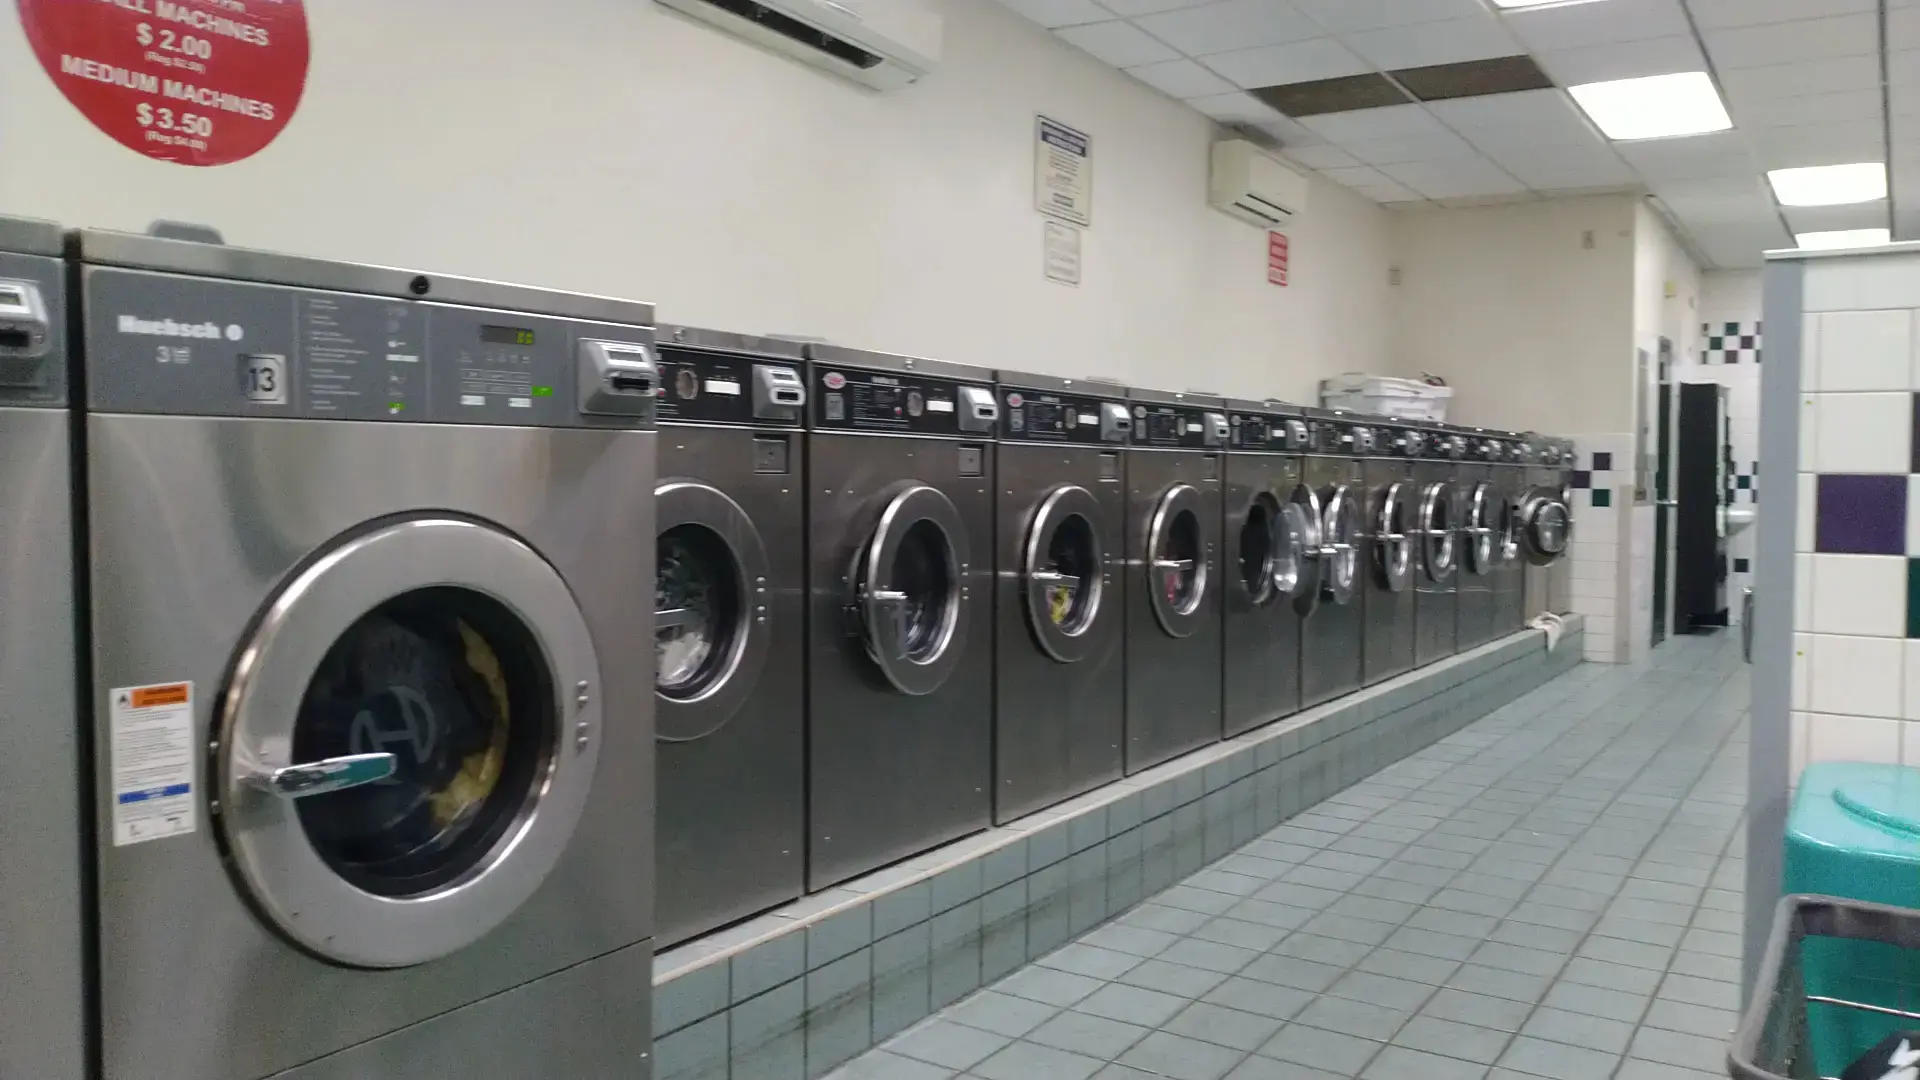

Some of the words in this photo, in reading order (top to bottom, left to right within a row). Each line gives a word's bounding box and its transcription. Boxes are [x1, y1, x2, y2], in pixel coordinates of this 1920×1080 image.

[60, 54, 159, 94] MEDIUM
[163, 79, 275, 121] MACHINES
[248, 366, 277, 393] 13
